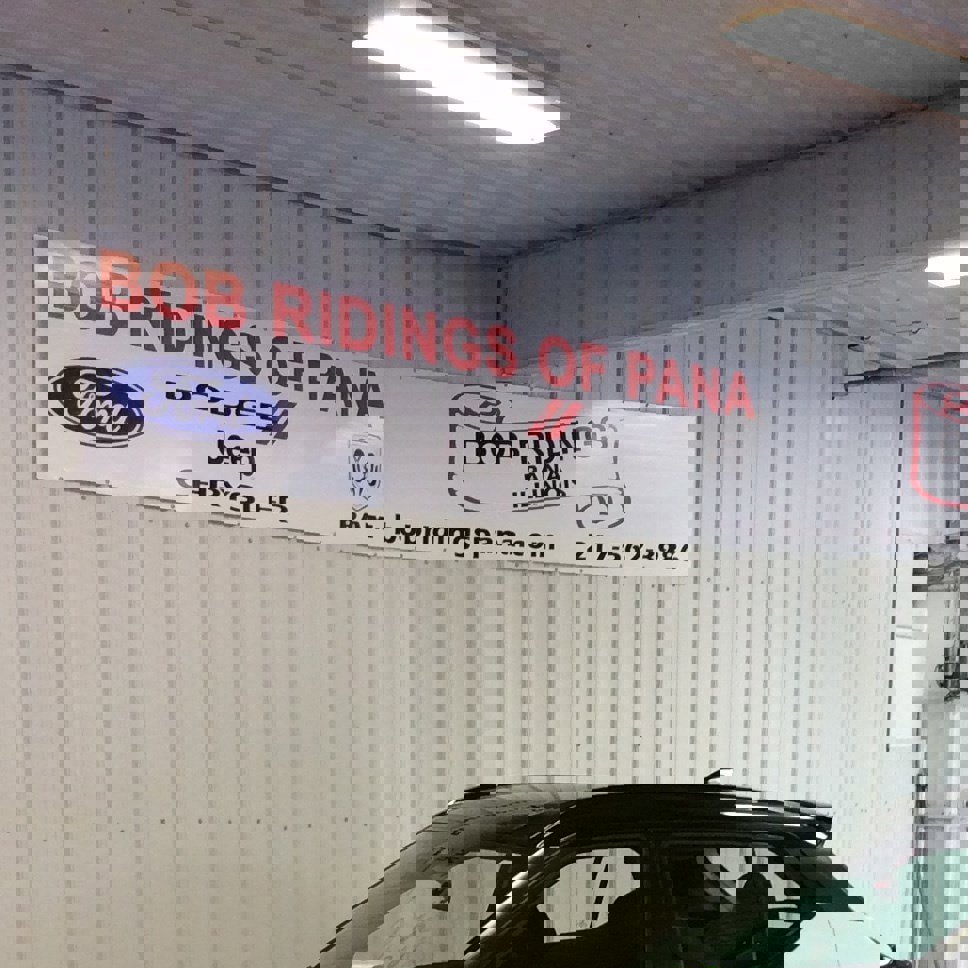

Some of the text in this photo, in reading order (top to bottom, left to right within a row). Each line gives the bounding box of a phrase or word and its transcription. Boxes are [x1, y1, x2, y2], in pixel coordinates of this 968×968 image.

[99, 248, 248, 331] BOB
[272, 281, 519, 379] RIDINGS
[538, 335, 608, 392] OF
[627, 351, 757, 420] PANA
